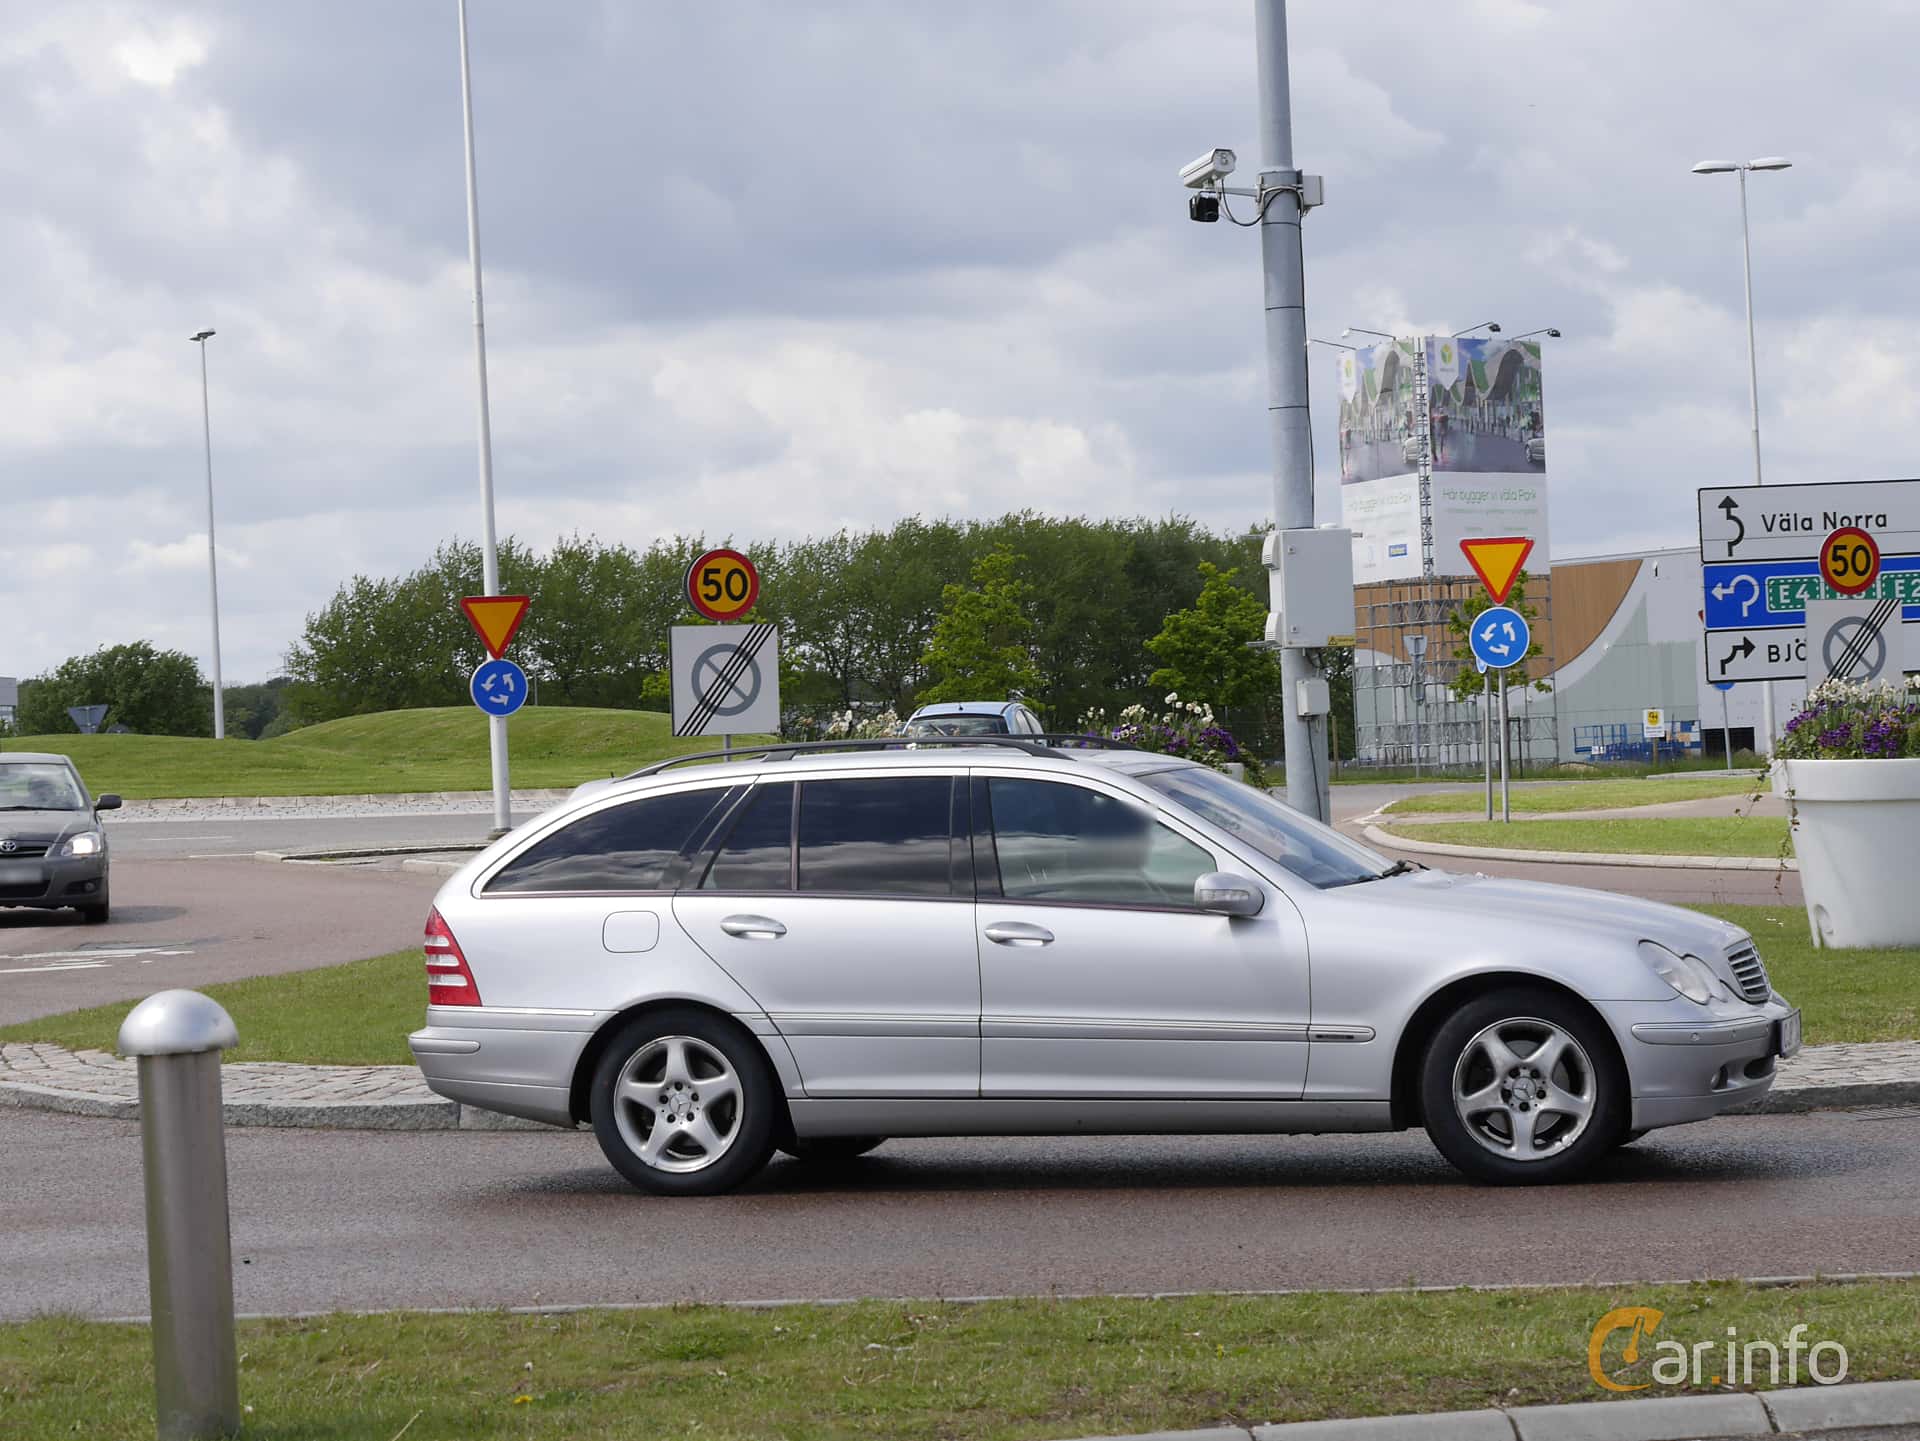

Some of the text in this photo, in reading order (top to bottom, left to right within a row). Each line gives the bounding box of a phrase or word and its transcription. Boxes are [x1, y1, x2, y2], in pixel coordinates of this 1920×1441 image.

[1761, 511, 1888, 533] Väla Norra
[1831, 544, 1871, 576] 50
[703, 568, 748, 601] 50
